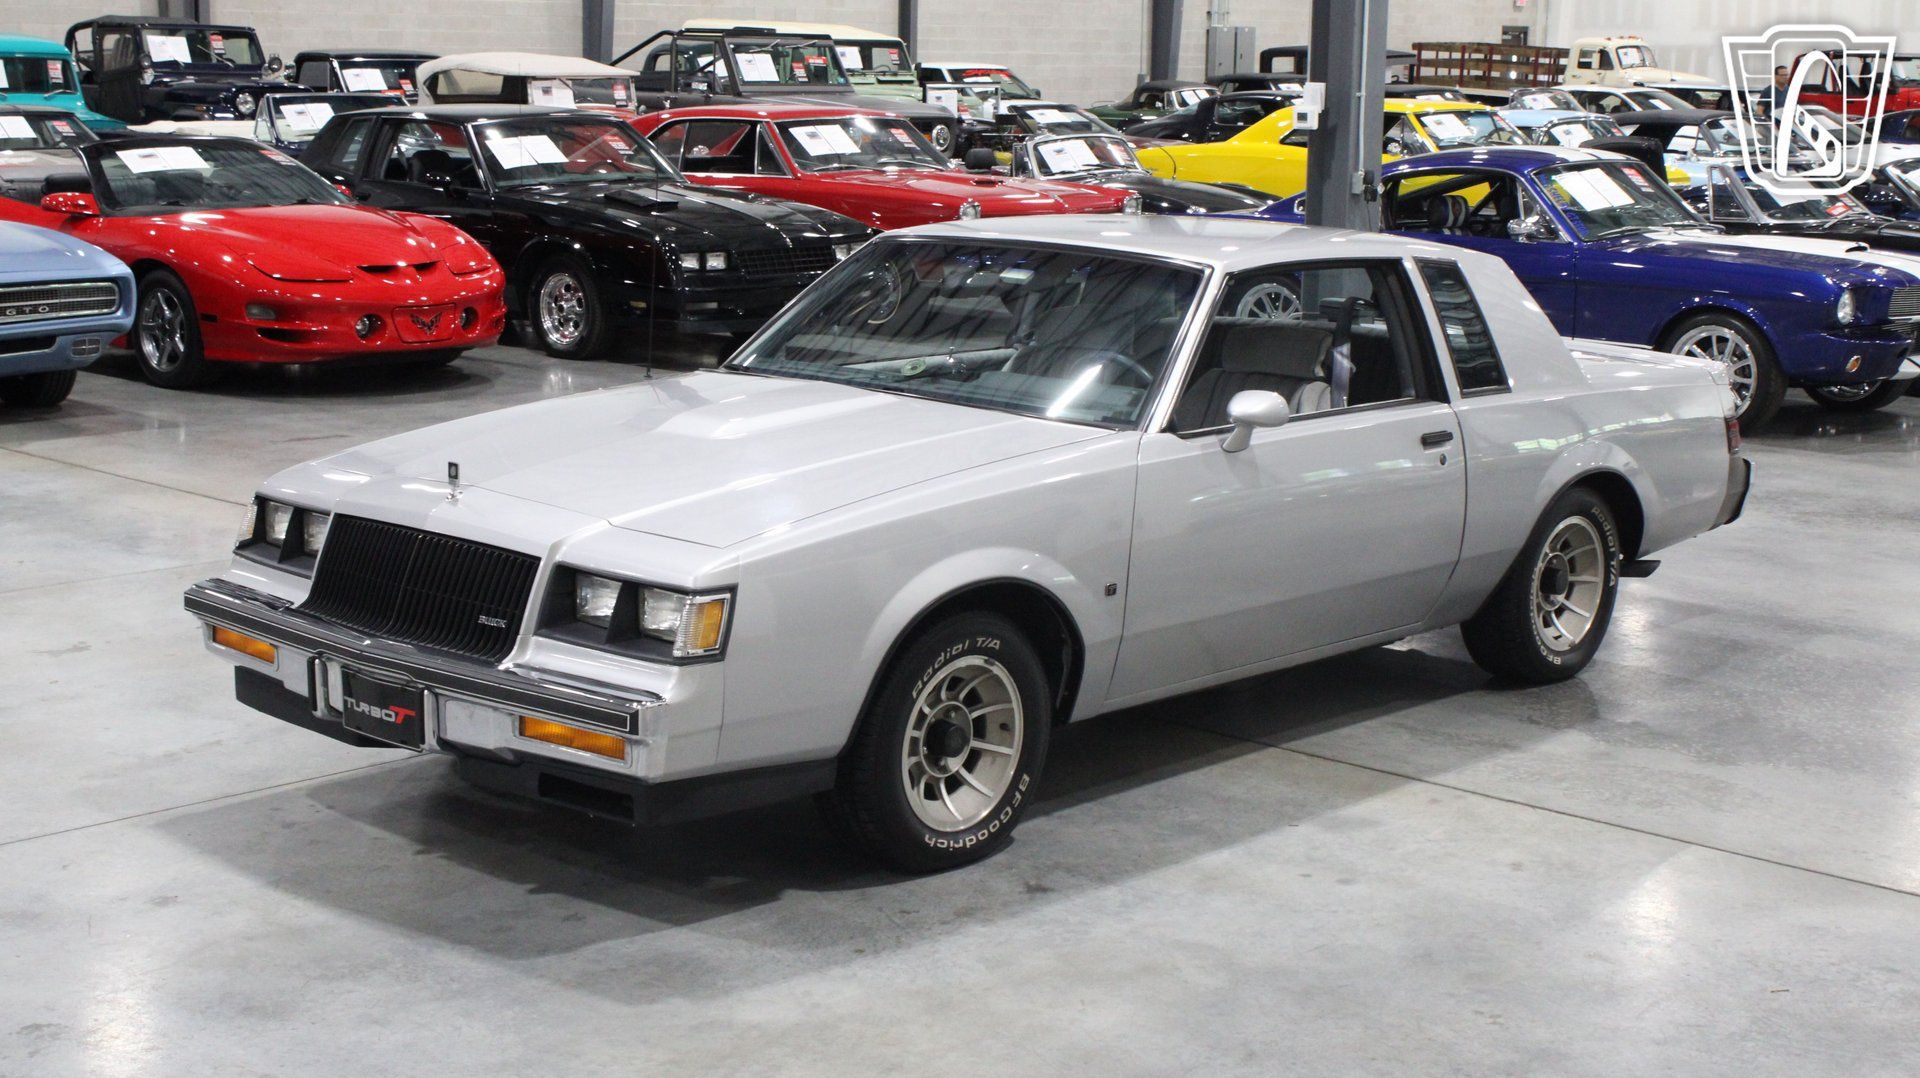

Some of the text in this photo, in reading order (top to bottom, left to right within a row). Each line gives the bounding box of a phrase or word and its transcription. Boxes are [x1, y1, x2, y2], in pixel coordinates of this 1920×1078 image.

[5, 305, 49, 316] GTO
[911, 637, 1001, 699] Radial T/A
[924, 773, 1030, 851] BFGoodrich
